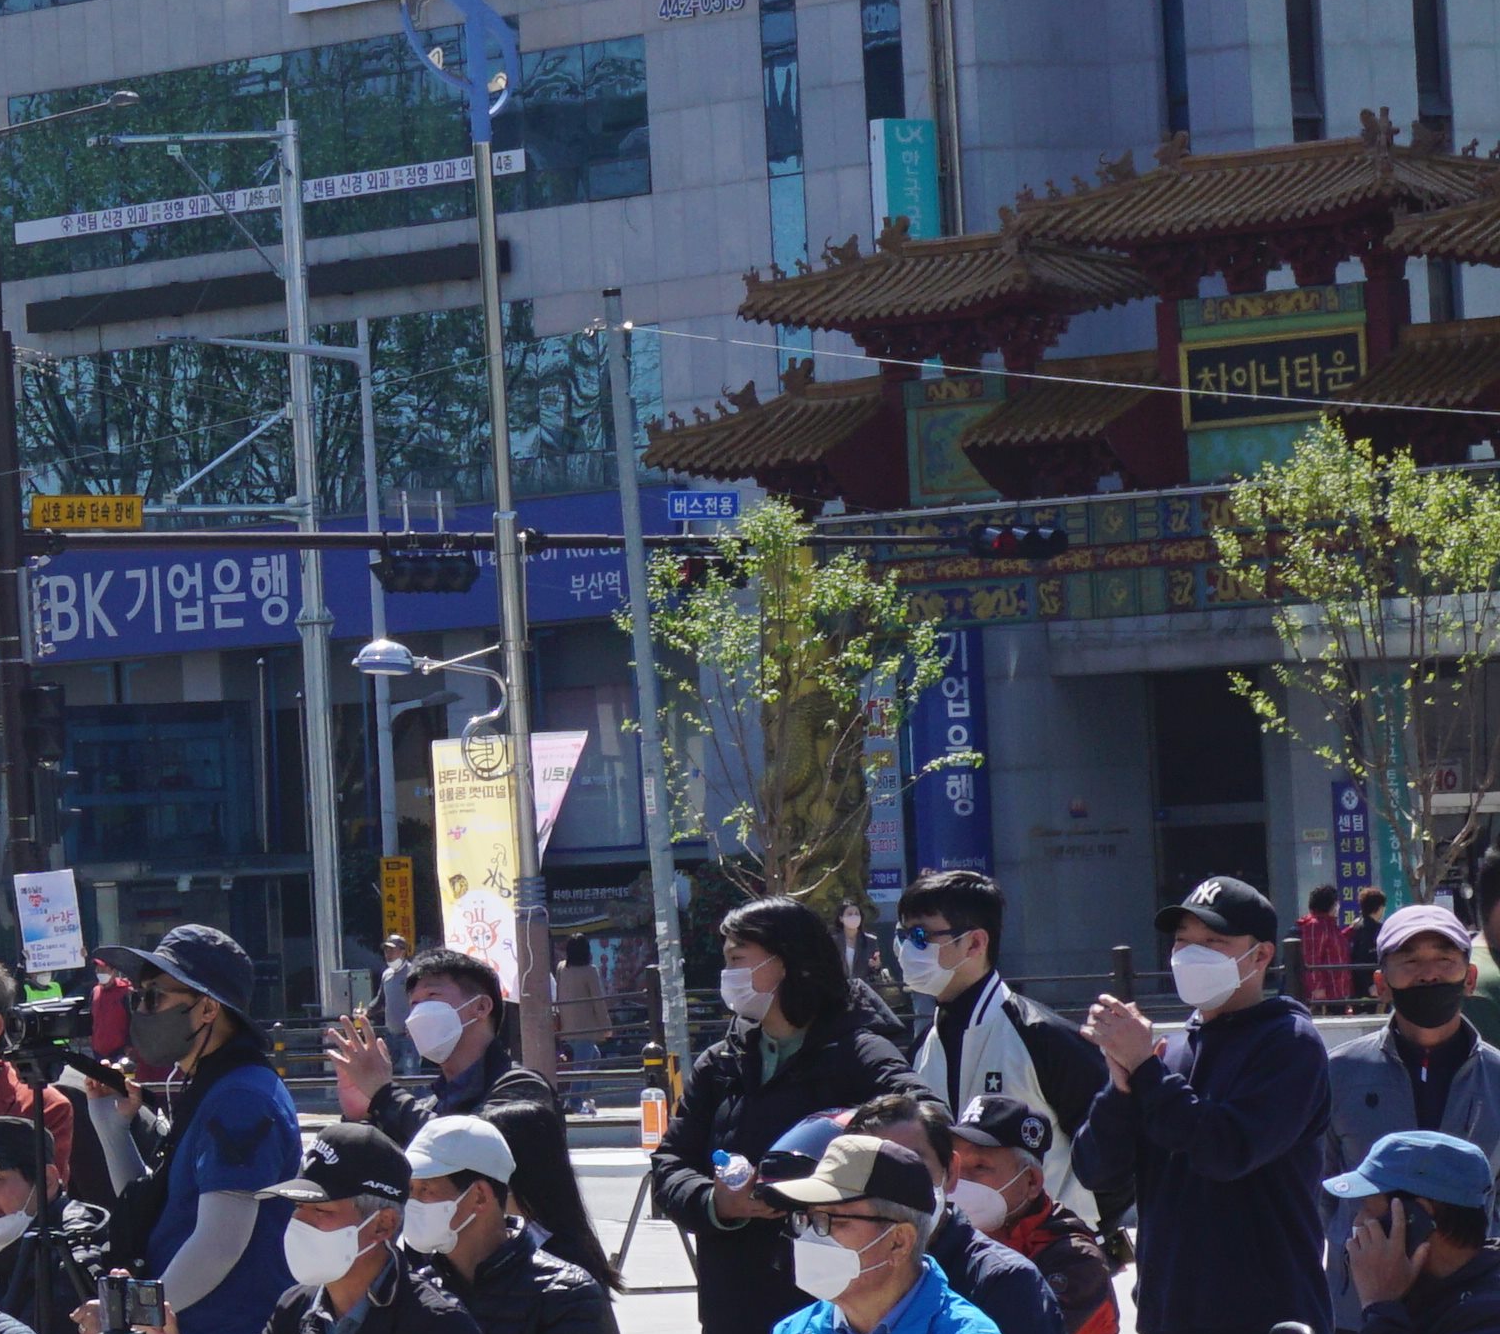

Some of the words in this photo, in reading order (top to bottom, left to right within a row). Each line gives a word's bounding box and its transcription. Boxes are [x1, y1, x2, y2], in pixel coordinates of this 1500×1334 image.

[313, 180, 335, 198] 센텀
[340, 175, 362, 194] 신경
[367, 170, 390, 189] 외과
[406, 164, 429, 184] 정형
[434, 160, 456, 179] 외과
[76, 212, 98, 232] 센텀
[102, 208, 123, 228] 신경
[127, 204, 149, 224] 외과
[189, 194, 210, 215] 외과
[1196, 349, 1356, 405] 차이나타운
[41, 503, 62, 523] 신호
[90, 501, 111, 522] 단속
[114, 500, 135, 522] 장비
[674, 495, 734, 515] 버스전용
[125, 554, 290, 635] 기업은행
[570, 570, 622, 602] 부산역
[1338, 814, 1364, 832] 센텀
[1190, 881, 1222, 905] NY
[362, 1179, 403, 1198] APEX
